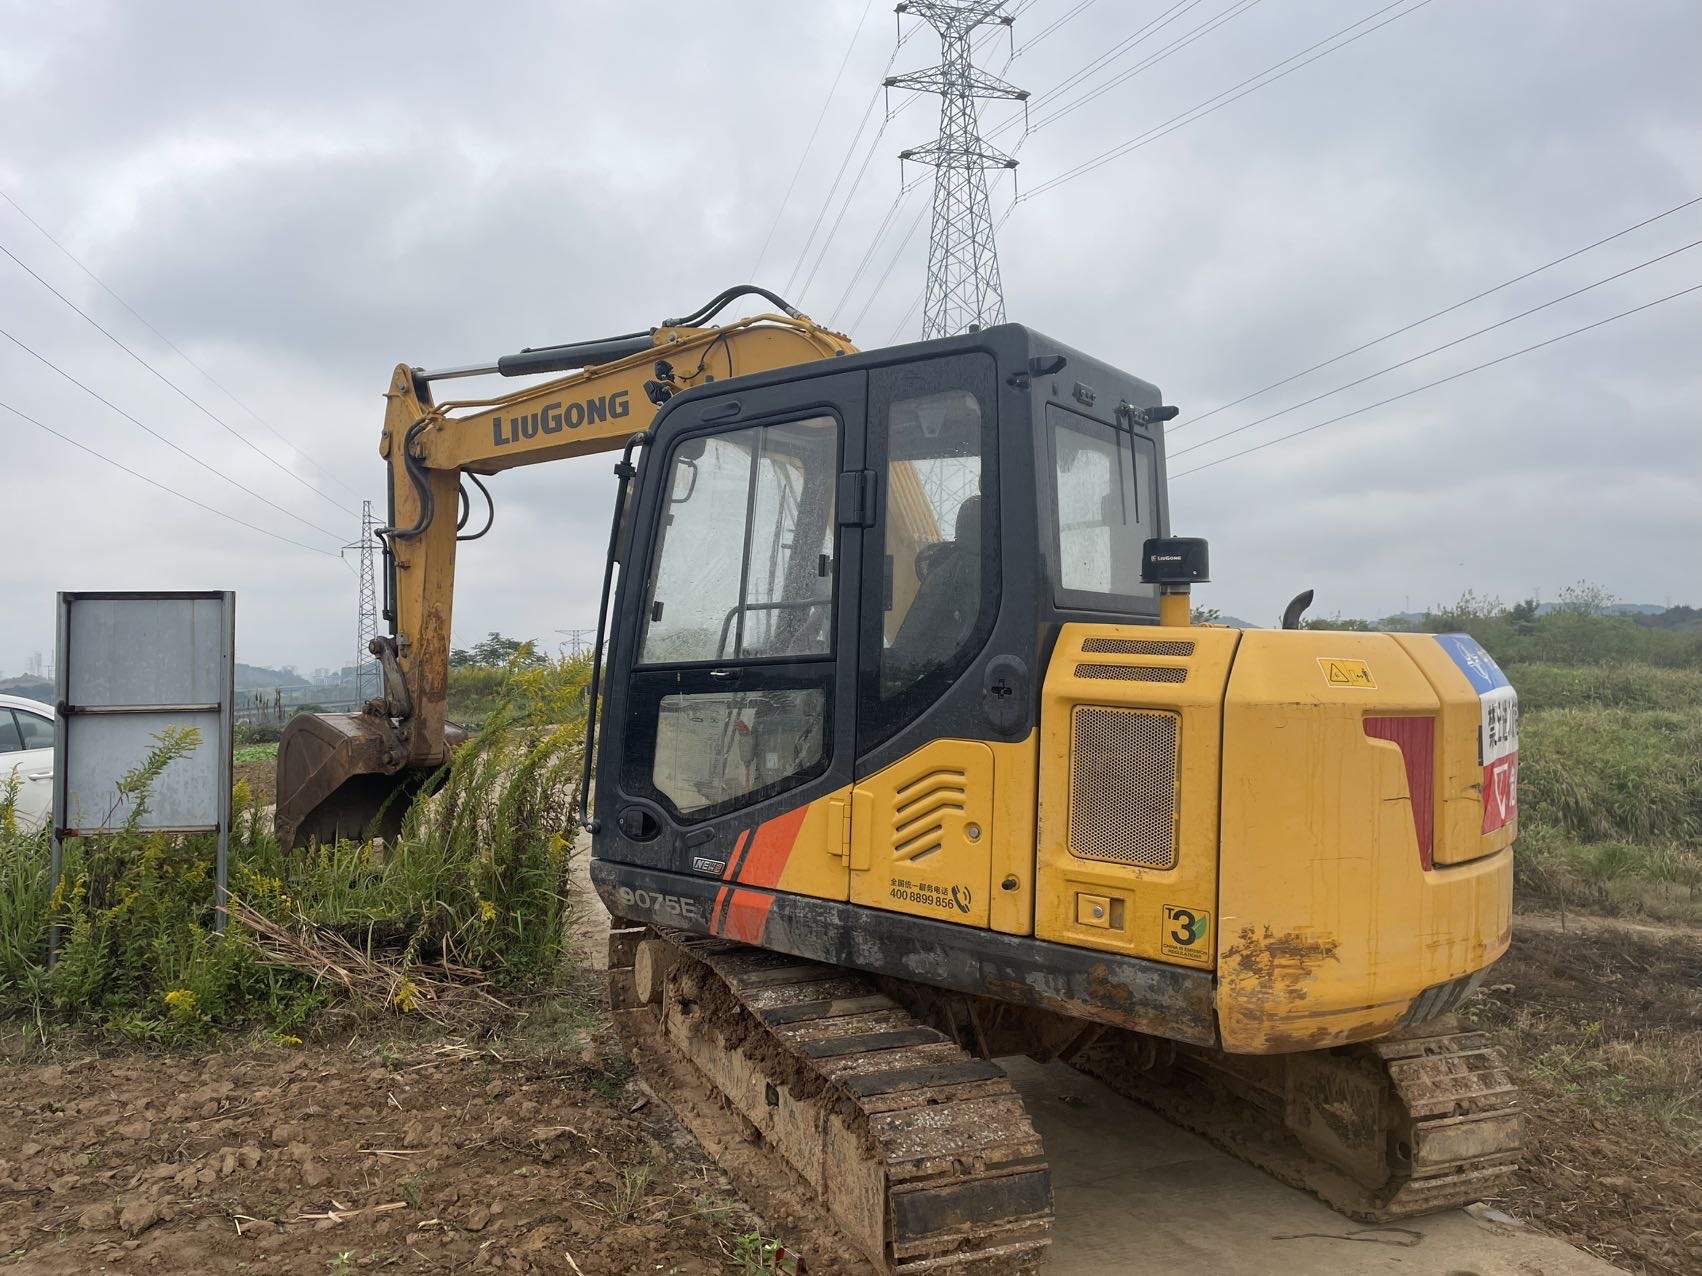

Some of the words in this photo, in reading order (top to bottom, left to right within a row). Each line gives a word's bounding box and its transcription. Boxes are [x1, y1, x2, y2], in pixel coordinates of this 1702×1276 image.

[890, 888, 908, 901] 400
[909, 891, 934, 906] 8899
[935, 896, 954, 909] 856
